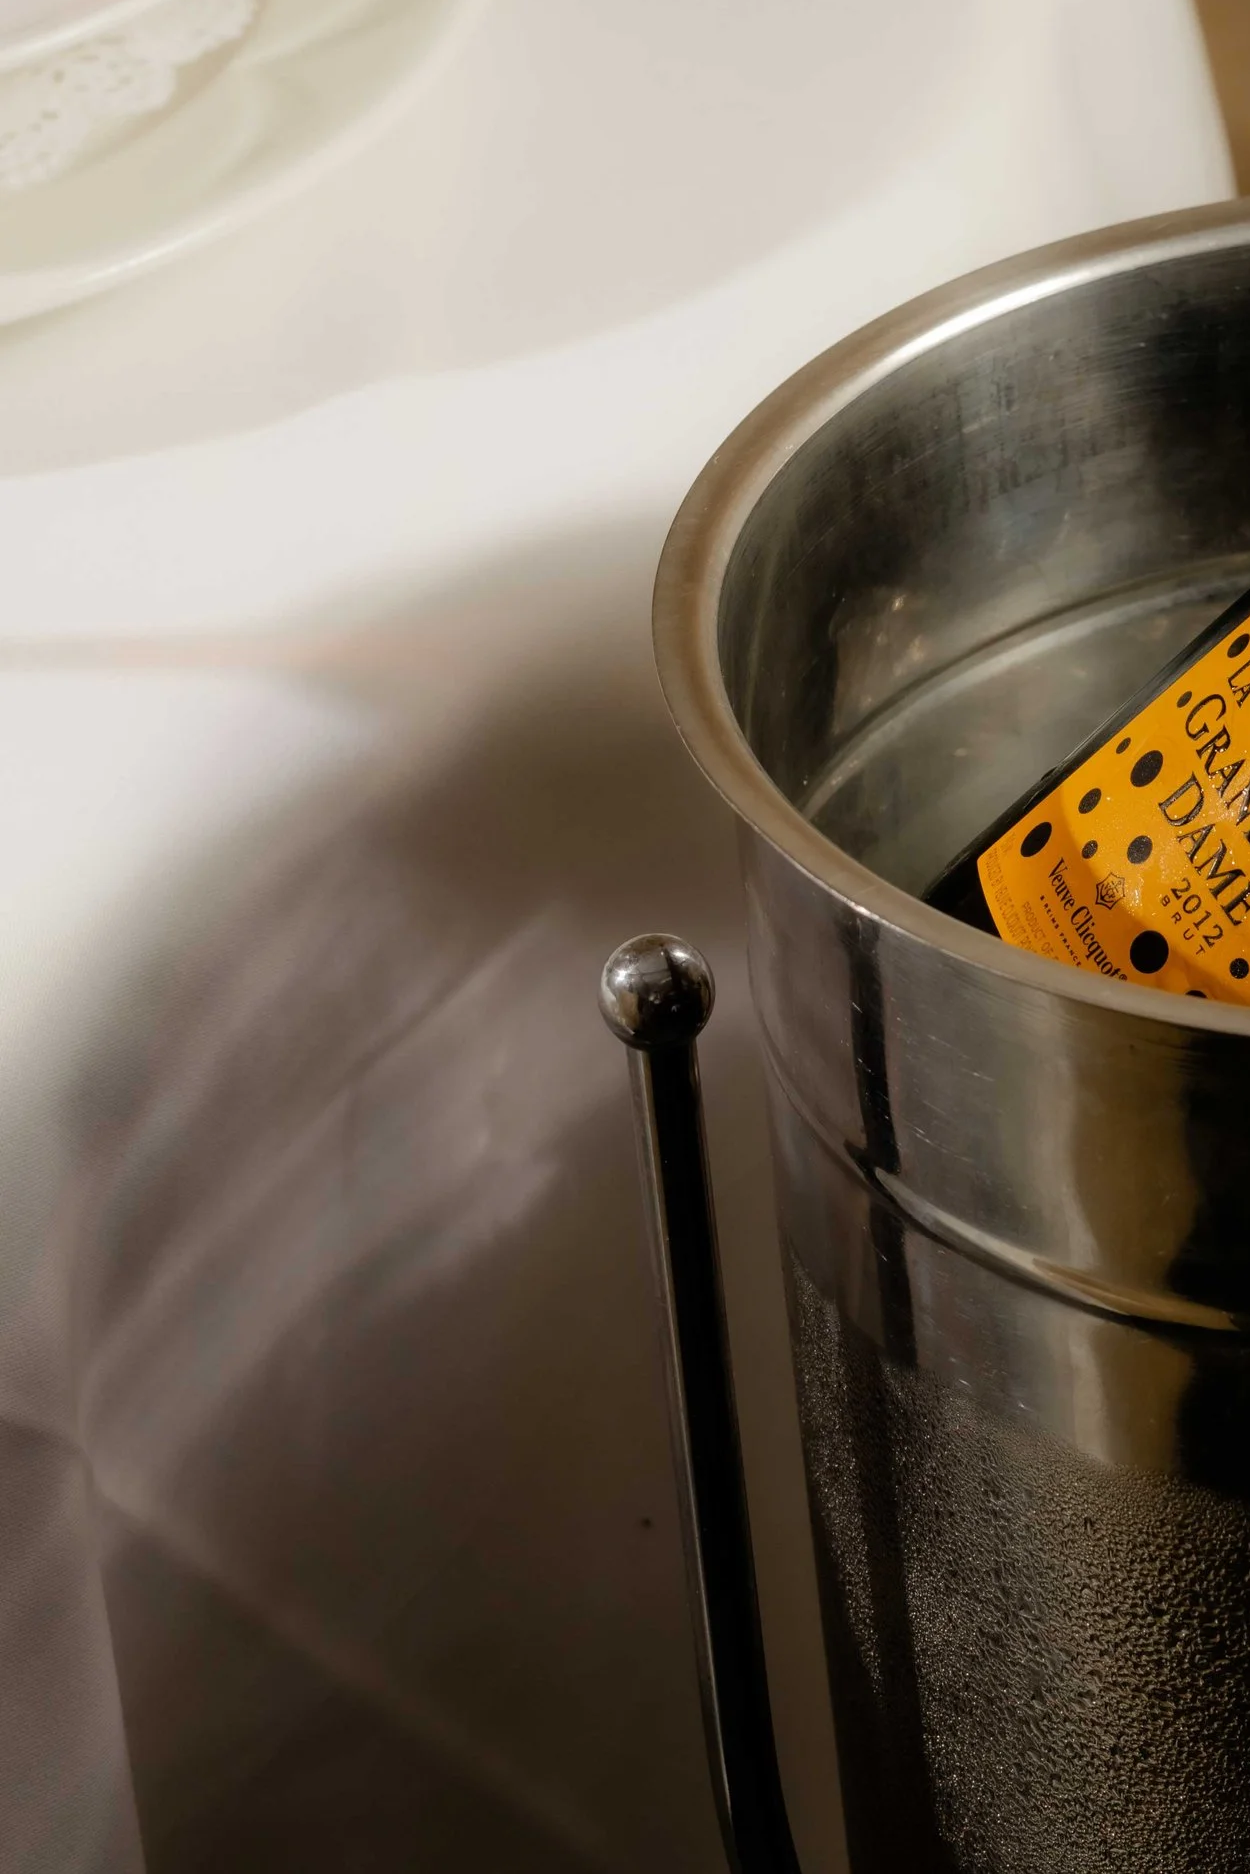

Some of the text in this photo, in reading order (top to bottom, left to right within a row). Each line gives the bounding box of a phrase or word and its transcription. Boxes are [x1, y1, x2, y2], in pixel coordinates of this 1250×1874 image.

[1048, 857, 1076, 911] Veuve
[1022, 901, 1046, 942] PRODUCT
[1161, 894, 1206, 955] BRUT
[1170, 877, 1224, 949] 2012
[1059, 932, 1082, 967] FRANCE
